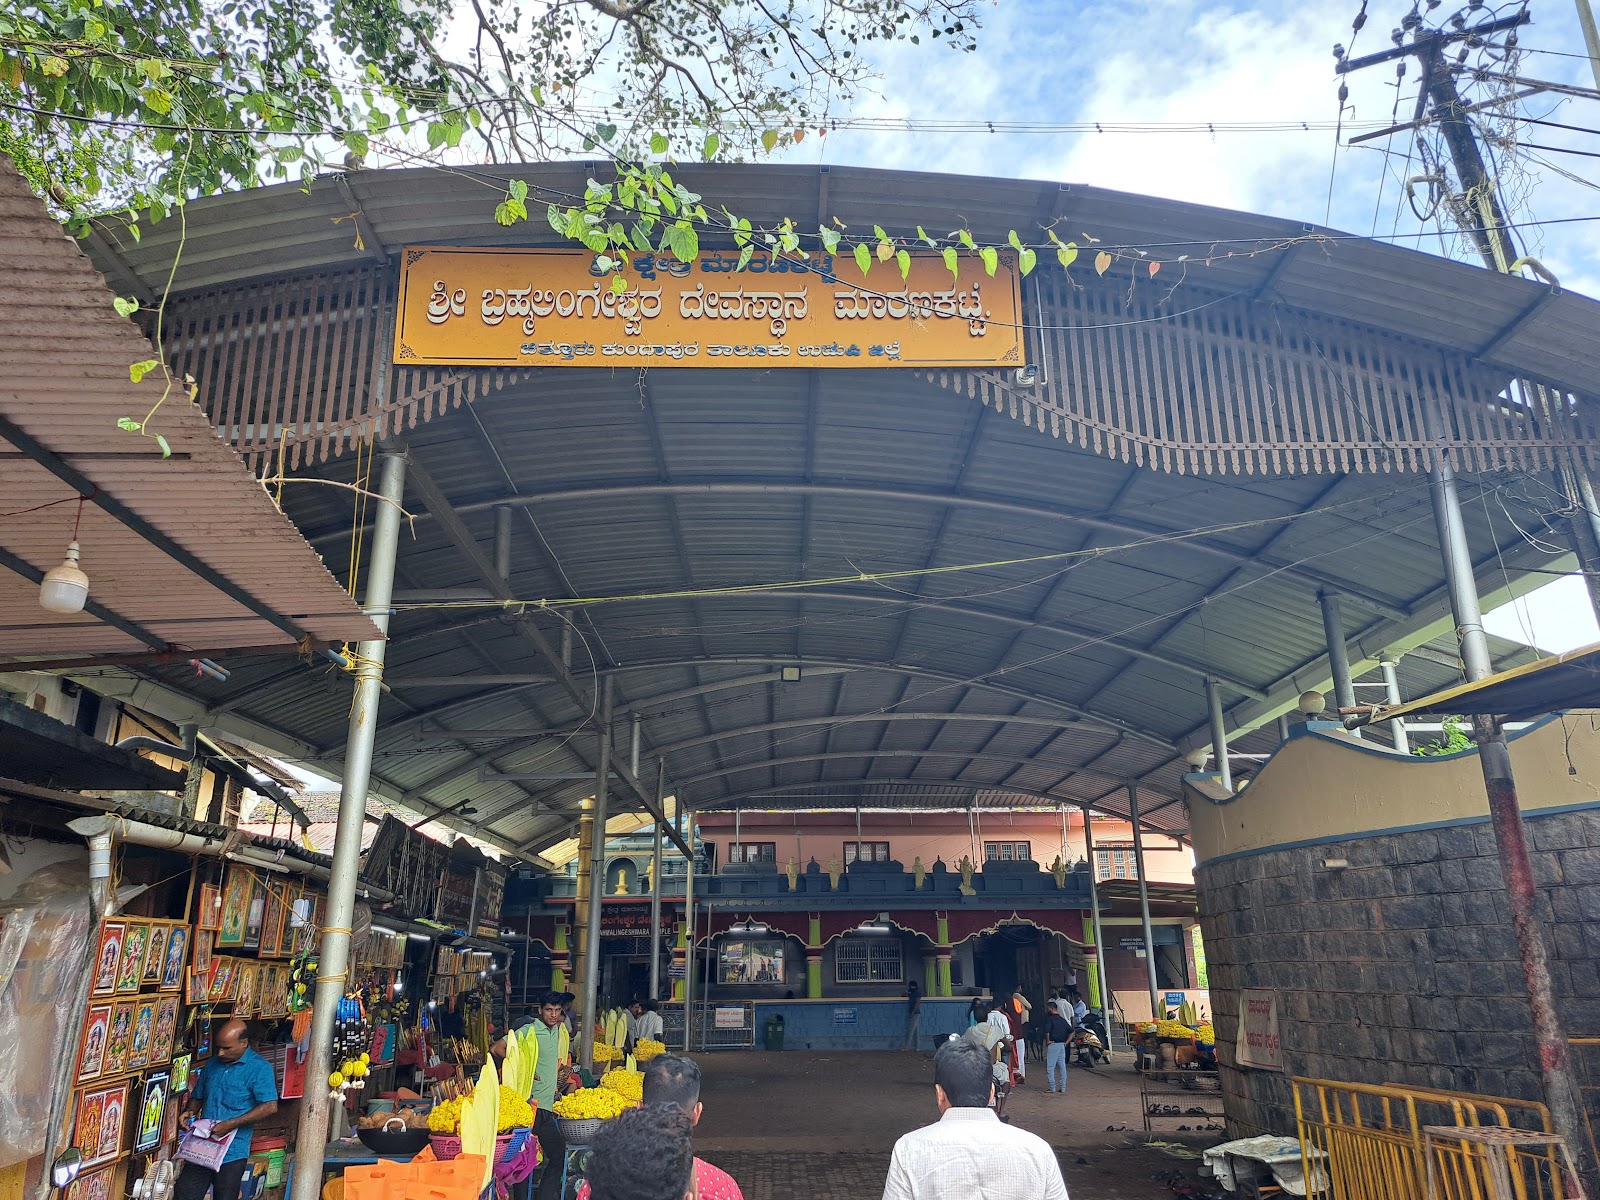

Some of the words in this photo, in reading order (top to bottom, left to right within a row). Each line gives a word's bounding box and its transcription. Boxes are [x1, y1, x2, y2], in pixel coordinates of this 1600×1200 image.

[634, 253, 692, 281] ಕ್ಷೇತ್ರ
[701, 254, 837, 283] ಮಾರಣಕಟ್ಟೆ
[426, 280, 468, 324] ಶ್ರೀ
[481, 280, 663, 335] ಬ್ರಹ್ಮಲಿಂಗೇಶ್ವರ
[680, 281, 808, 338] ದೇವಸ್ಥಾನ
[520, 340, 597, 360] ಚಿತ್ತೂರು
[601, 341, 699, 359] ಕುಂದಾಪುರ
[706, 341, 791, 356] ತಾಲೂಕು
[797, 341, 862, 356] ಉಡುಪಿ
[869, 341, 902, 360] ಜಿಲ್ಲೆ
[602, 915, 636, 928] ಲಿಂಗೇಶ್ವರ
[600, 928, 650, 936] AHMALINGESHWARA
